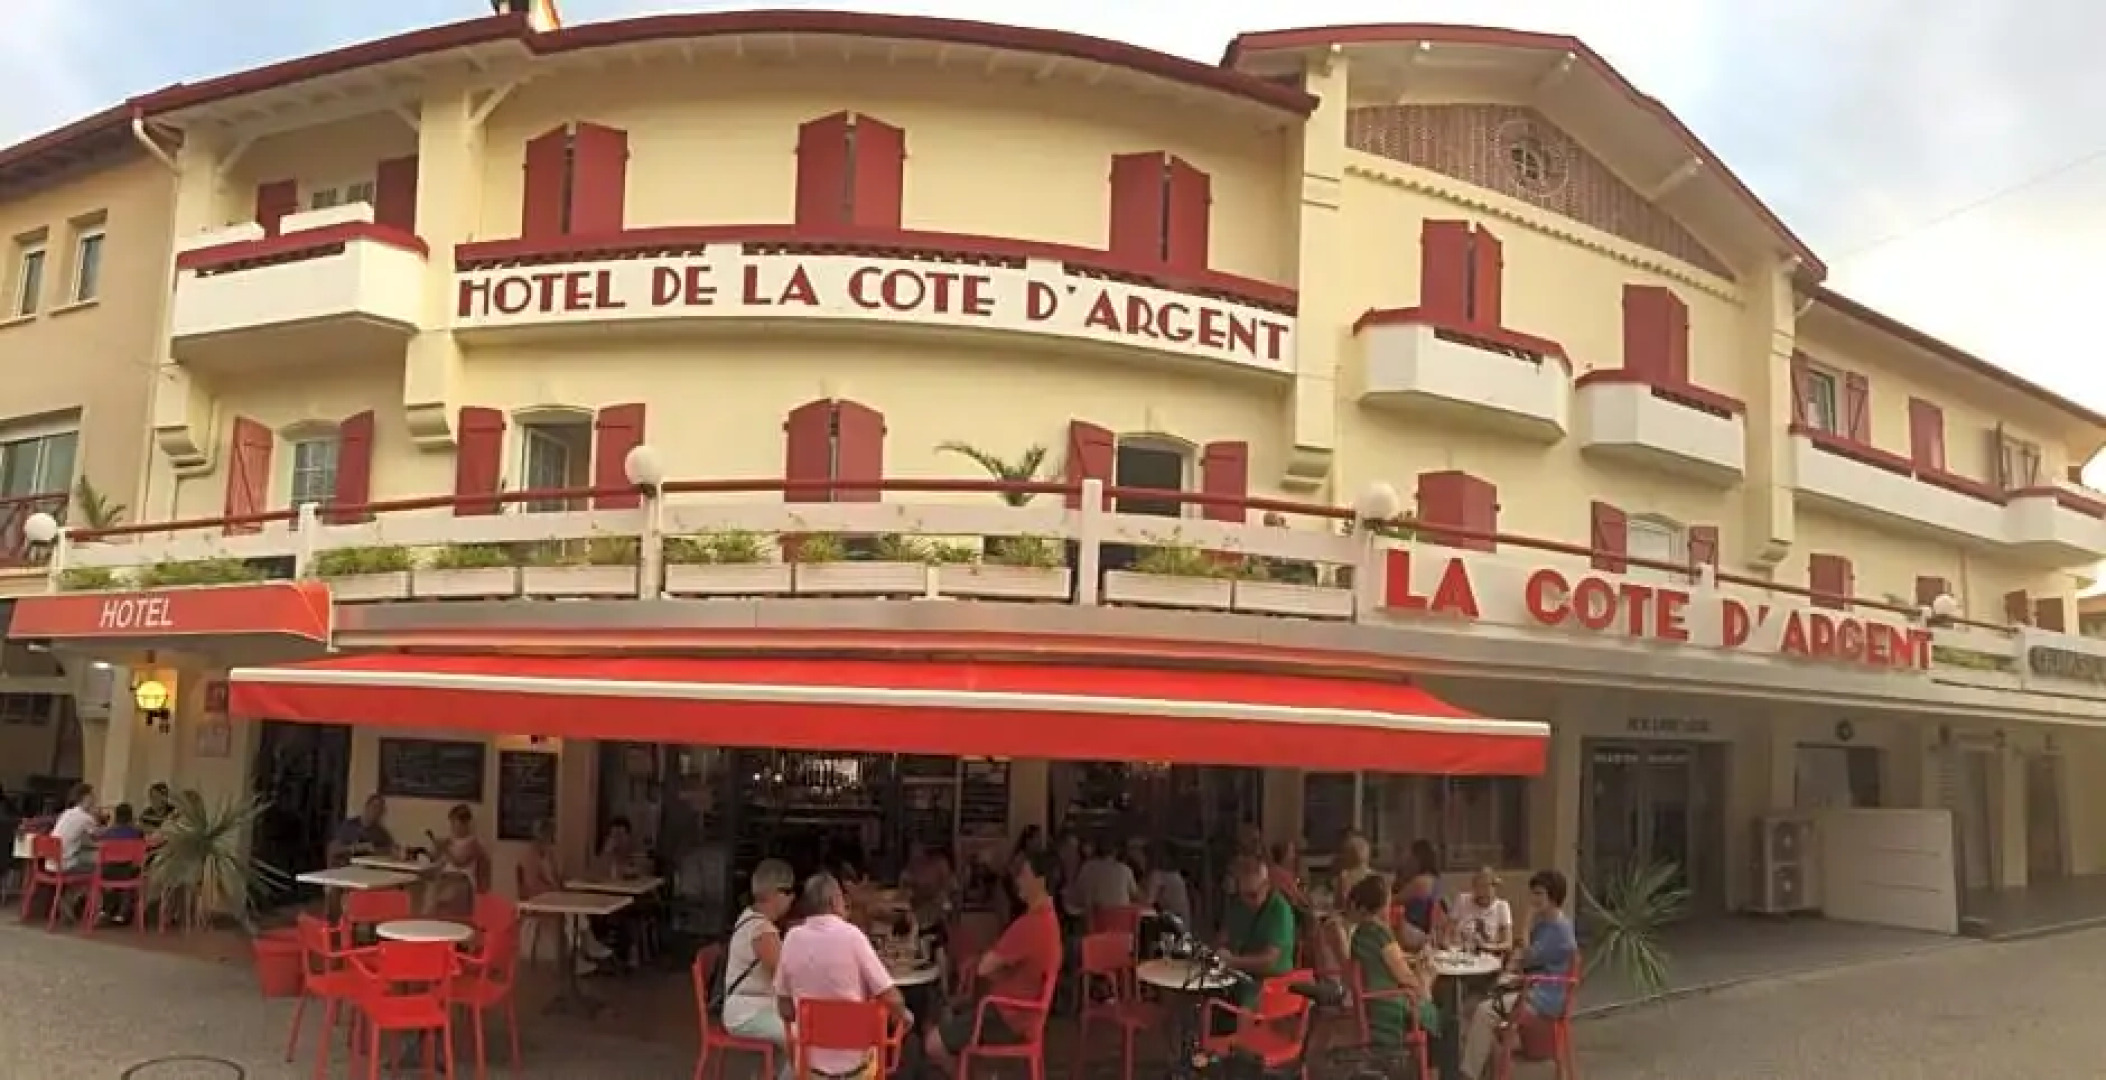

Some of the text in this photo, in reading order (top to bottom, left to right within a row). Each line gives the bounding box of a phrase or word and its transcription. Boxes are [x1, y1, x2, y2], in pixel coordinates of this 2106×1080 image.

[457, 269, 626, 317] HOTEL
[651, 265, 718, 306] DE
[743, 263, 820, 306] LA
[848, 266, 996, 317] COTE
[99, 597, 173, 628] HOTEL
[1386, 548, 1480, 618] LA
[1525, 568, 1690, 641] COTE
